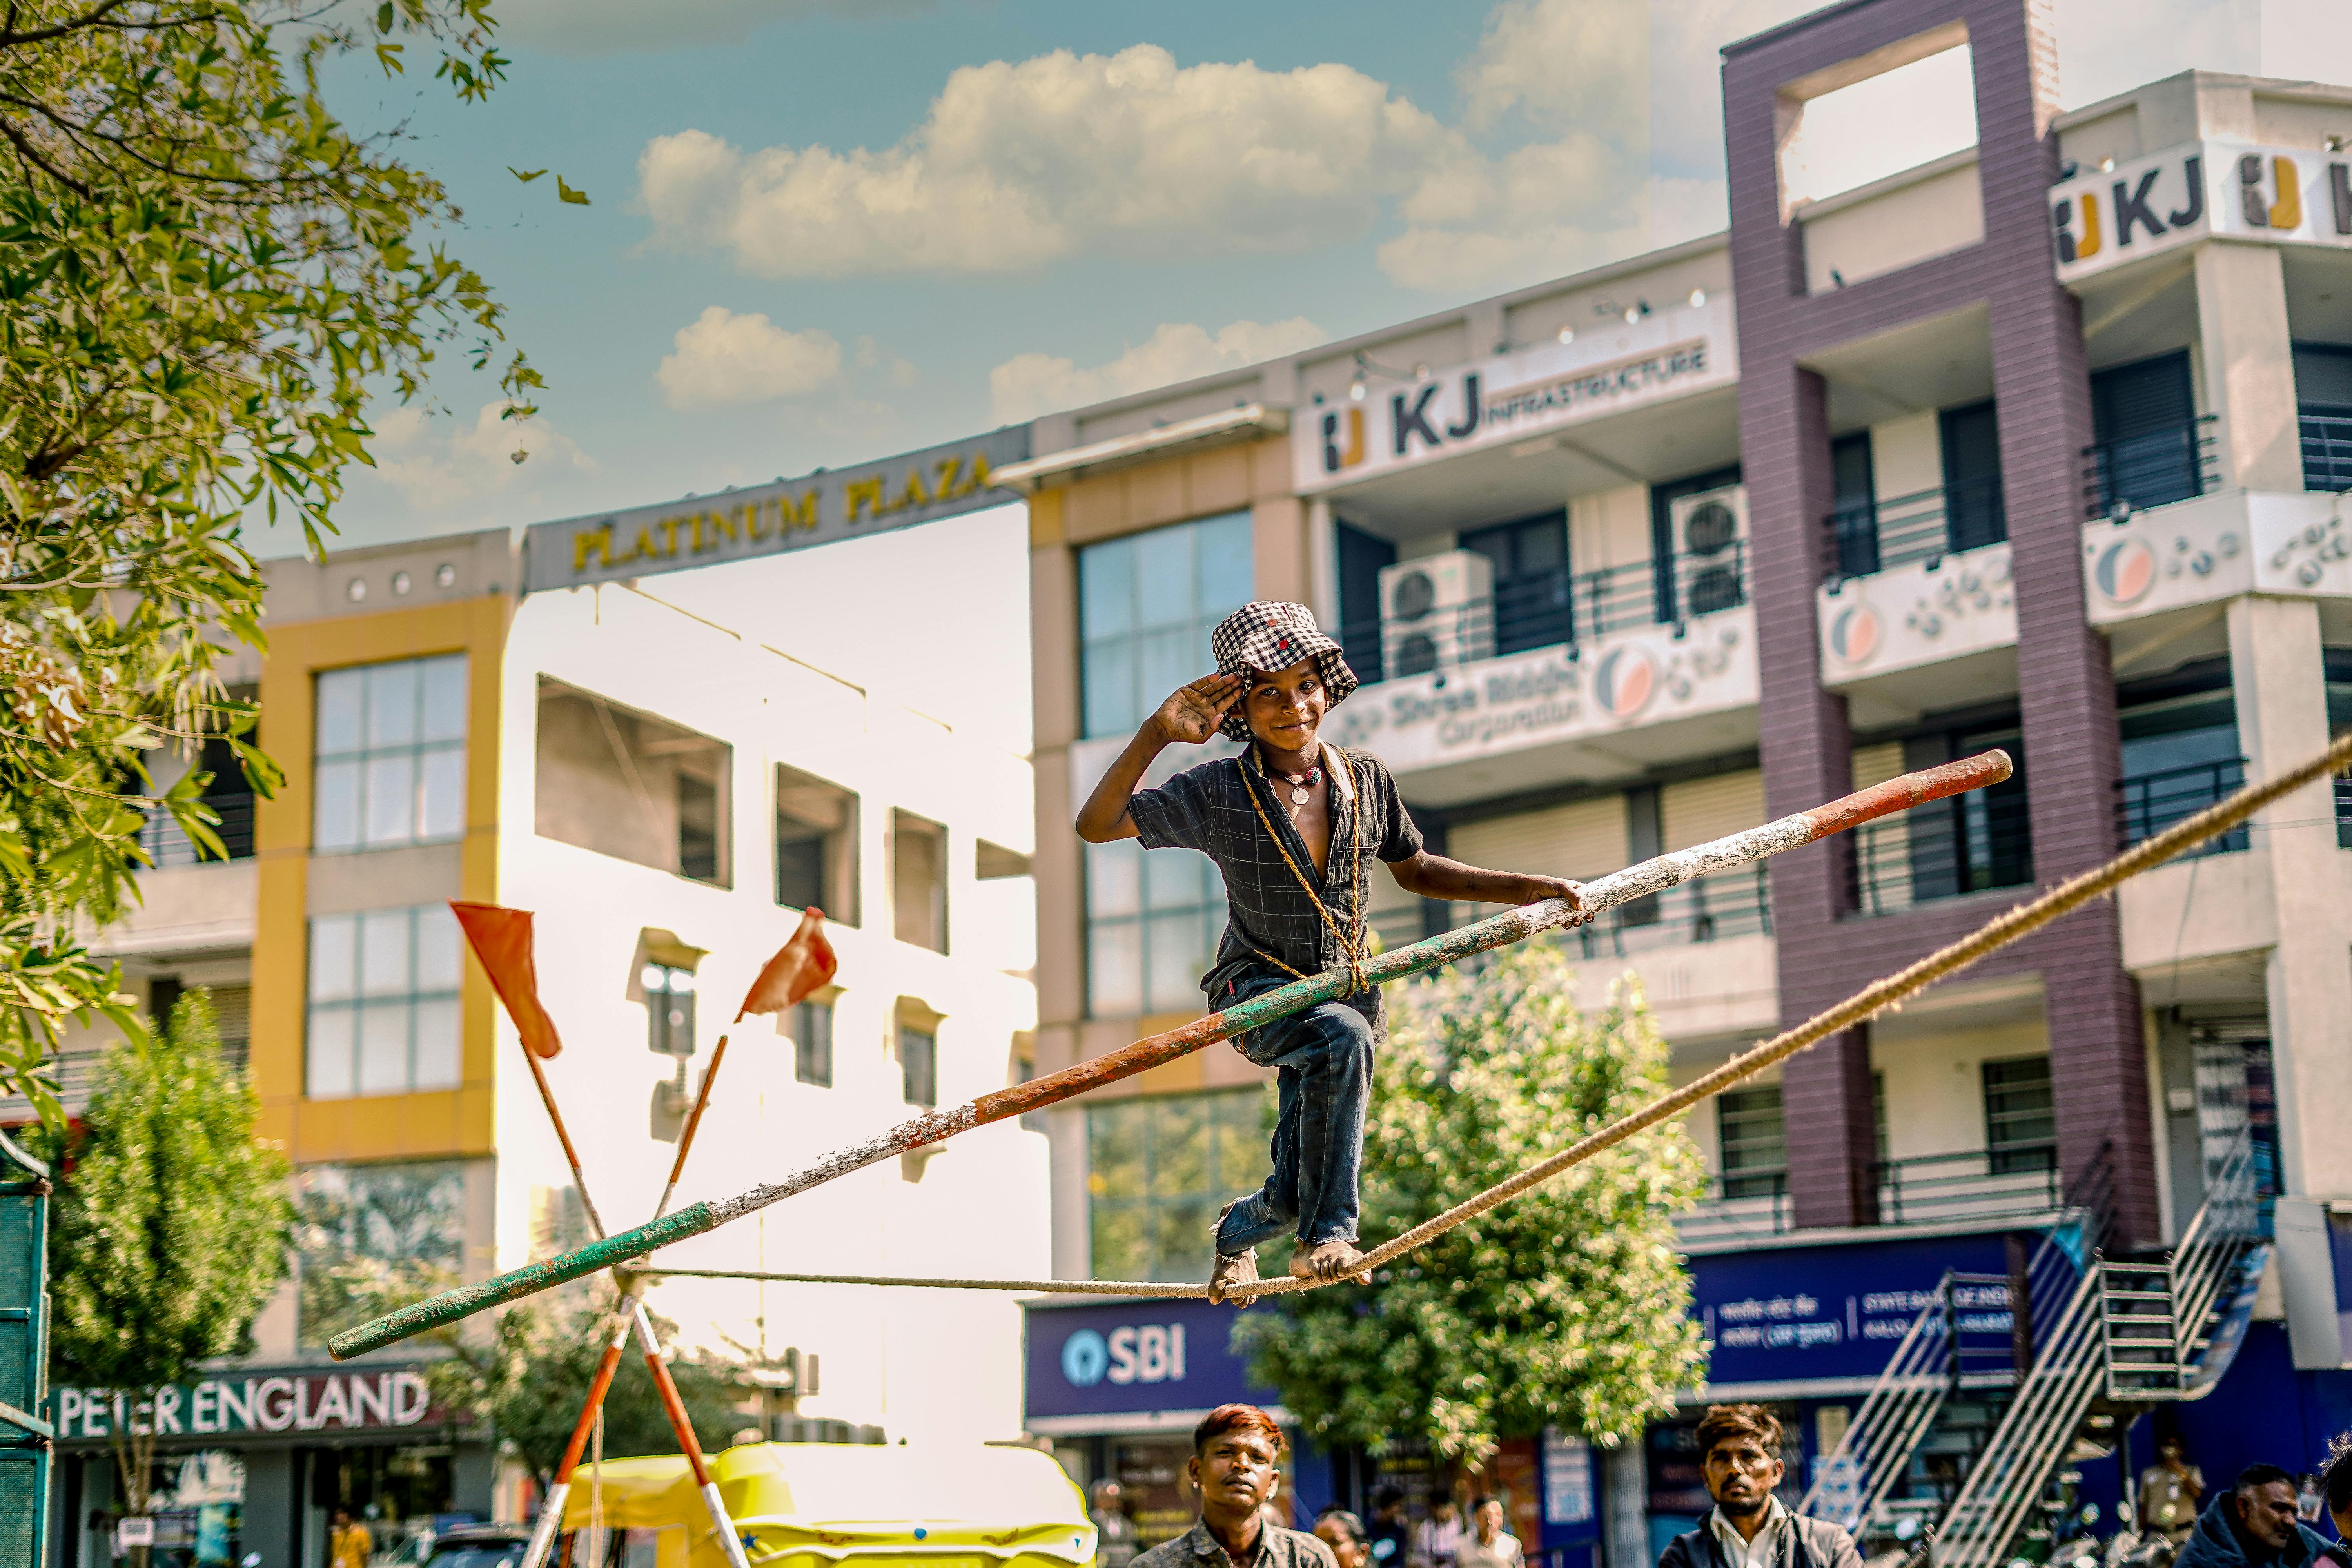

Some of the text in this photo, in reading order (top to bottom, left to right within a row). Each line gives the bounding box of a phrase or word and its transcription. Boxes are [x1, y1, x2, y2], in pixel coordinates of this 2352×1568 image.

[2112, 154, 2204, 246] KJ
[1392, 372, 1480, 456] KJ
[573, 451, 993, 571] PLATINUM PLAZA
[1107, 1321, 1187, 1386] SBI
[59, 1371, 431, 1438] PETER ENGLAND
